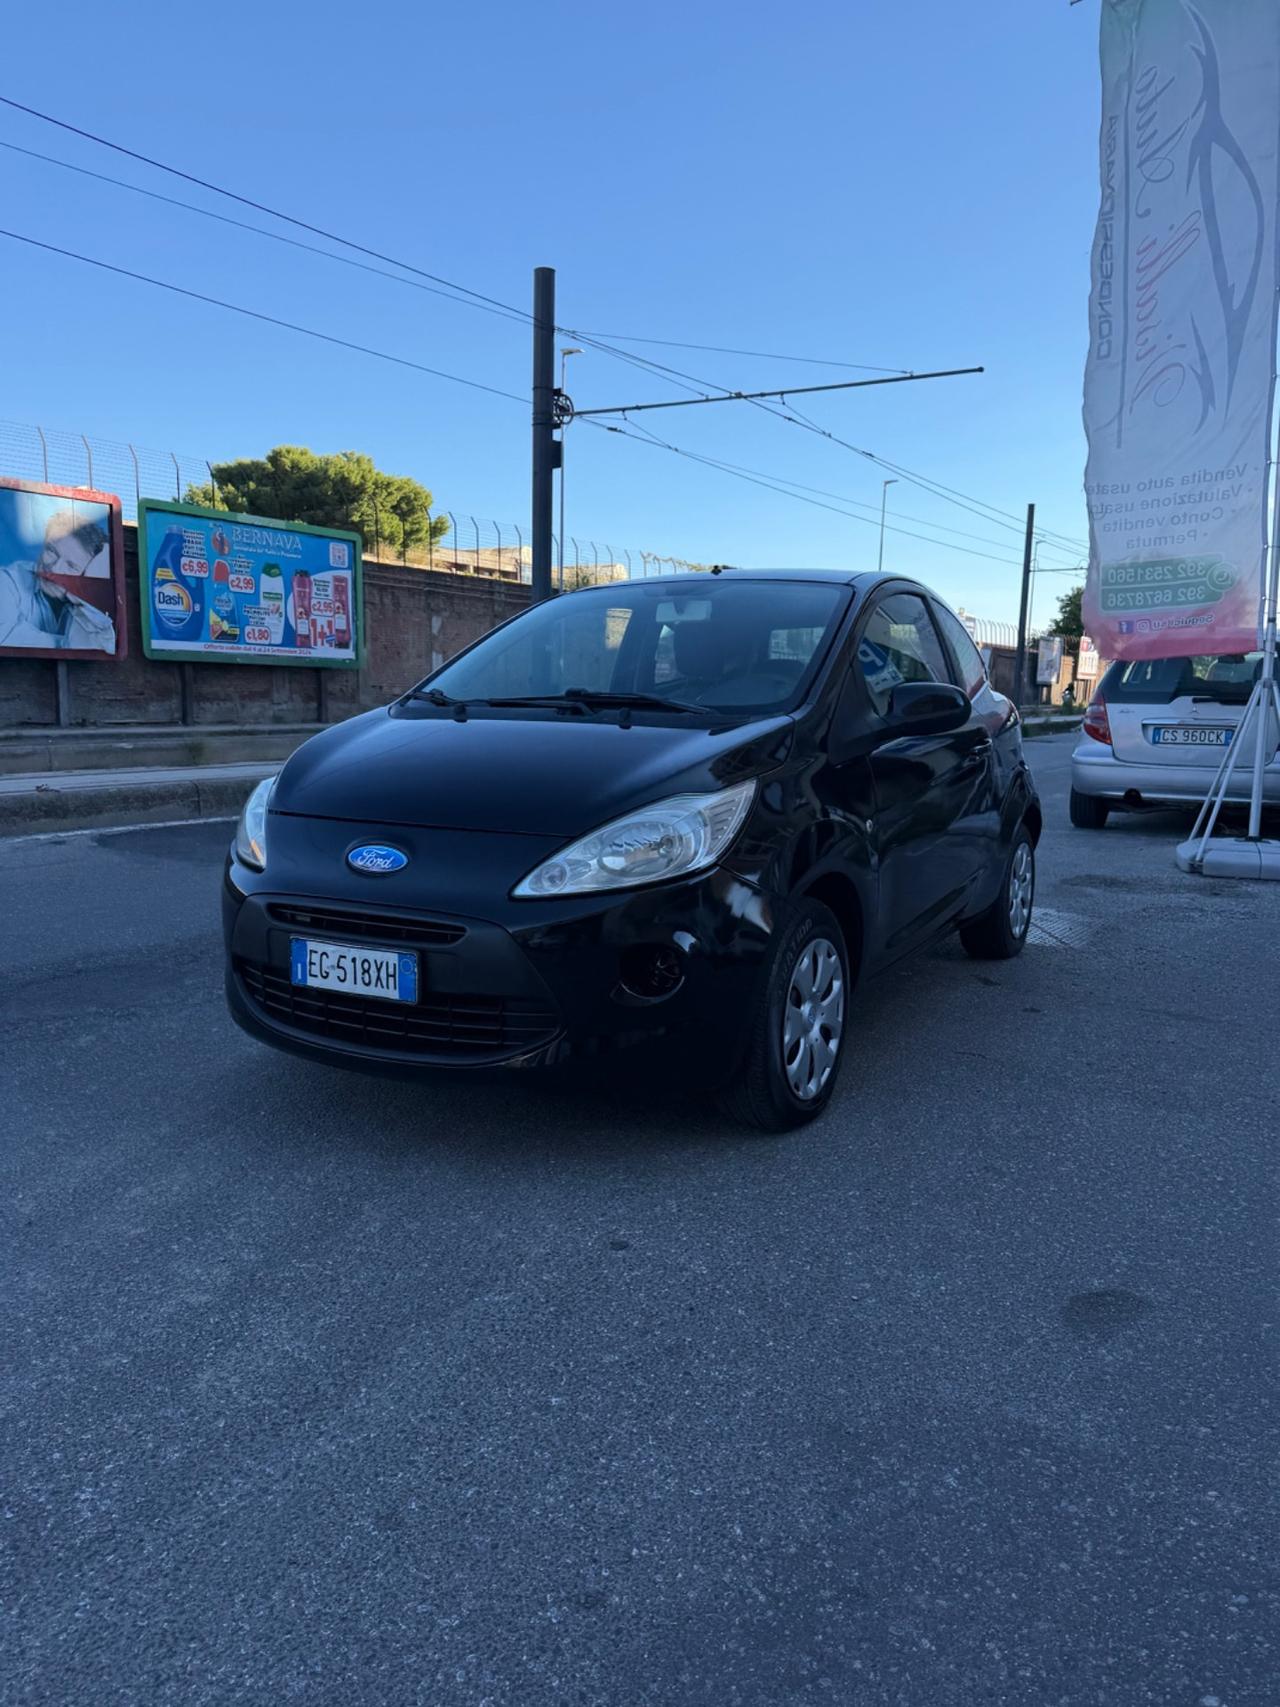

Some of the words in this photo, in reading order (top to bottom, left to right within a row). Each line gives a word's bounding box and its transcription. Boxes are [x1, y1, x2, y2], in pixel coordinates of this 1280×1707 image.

[231, 526, 303, 551] BERNAVA
[158, 591, 185, 606] Dash
[1162, 730, 1178, 743] CS
[1182, 730, 1225, 744] 960CK
[357, 848, 395, 869] Ford
[308, 949, 331, 980] EG
[336, 955, 398, 991] 518XH
